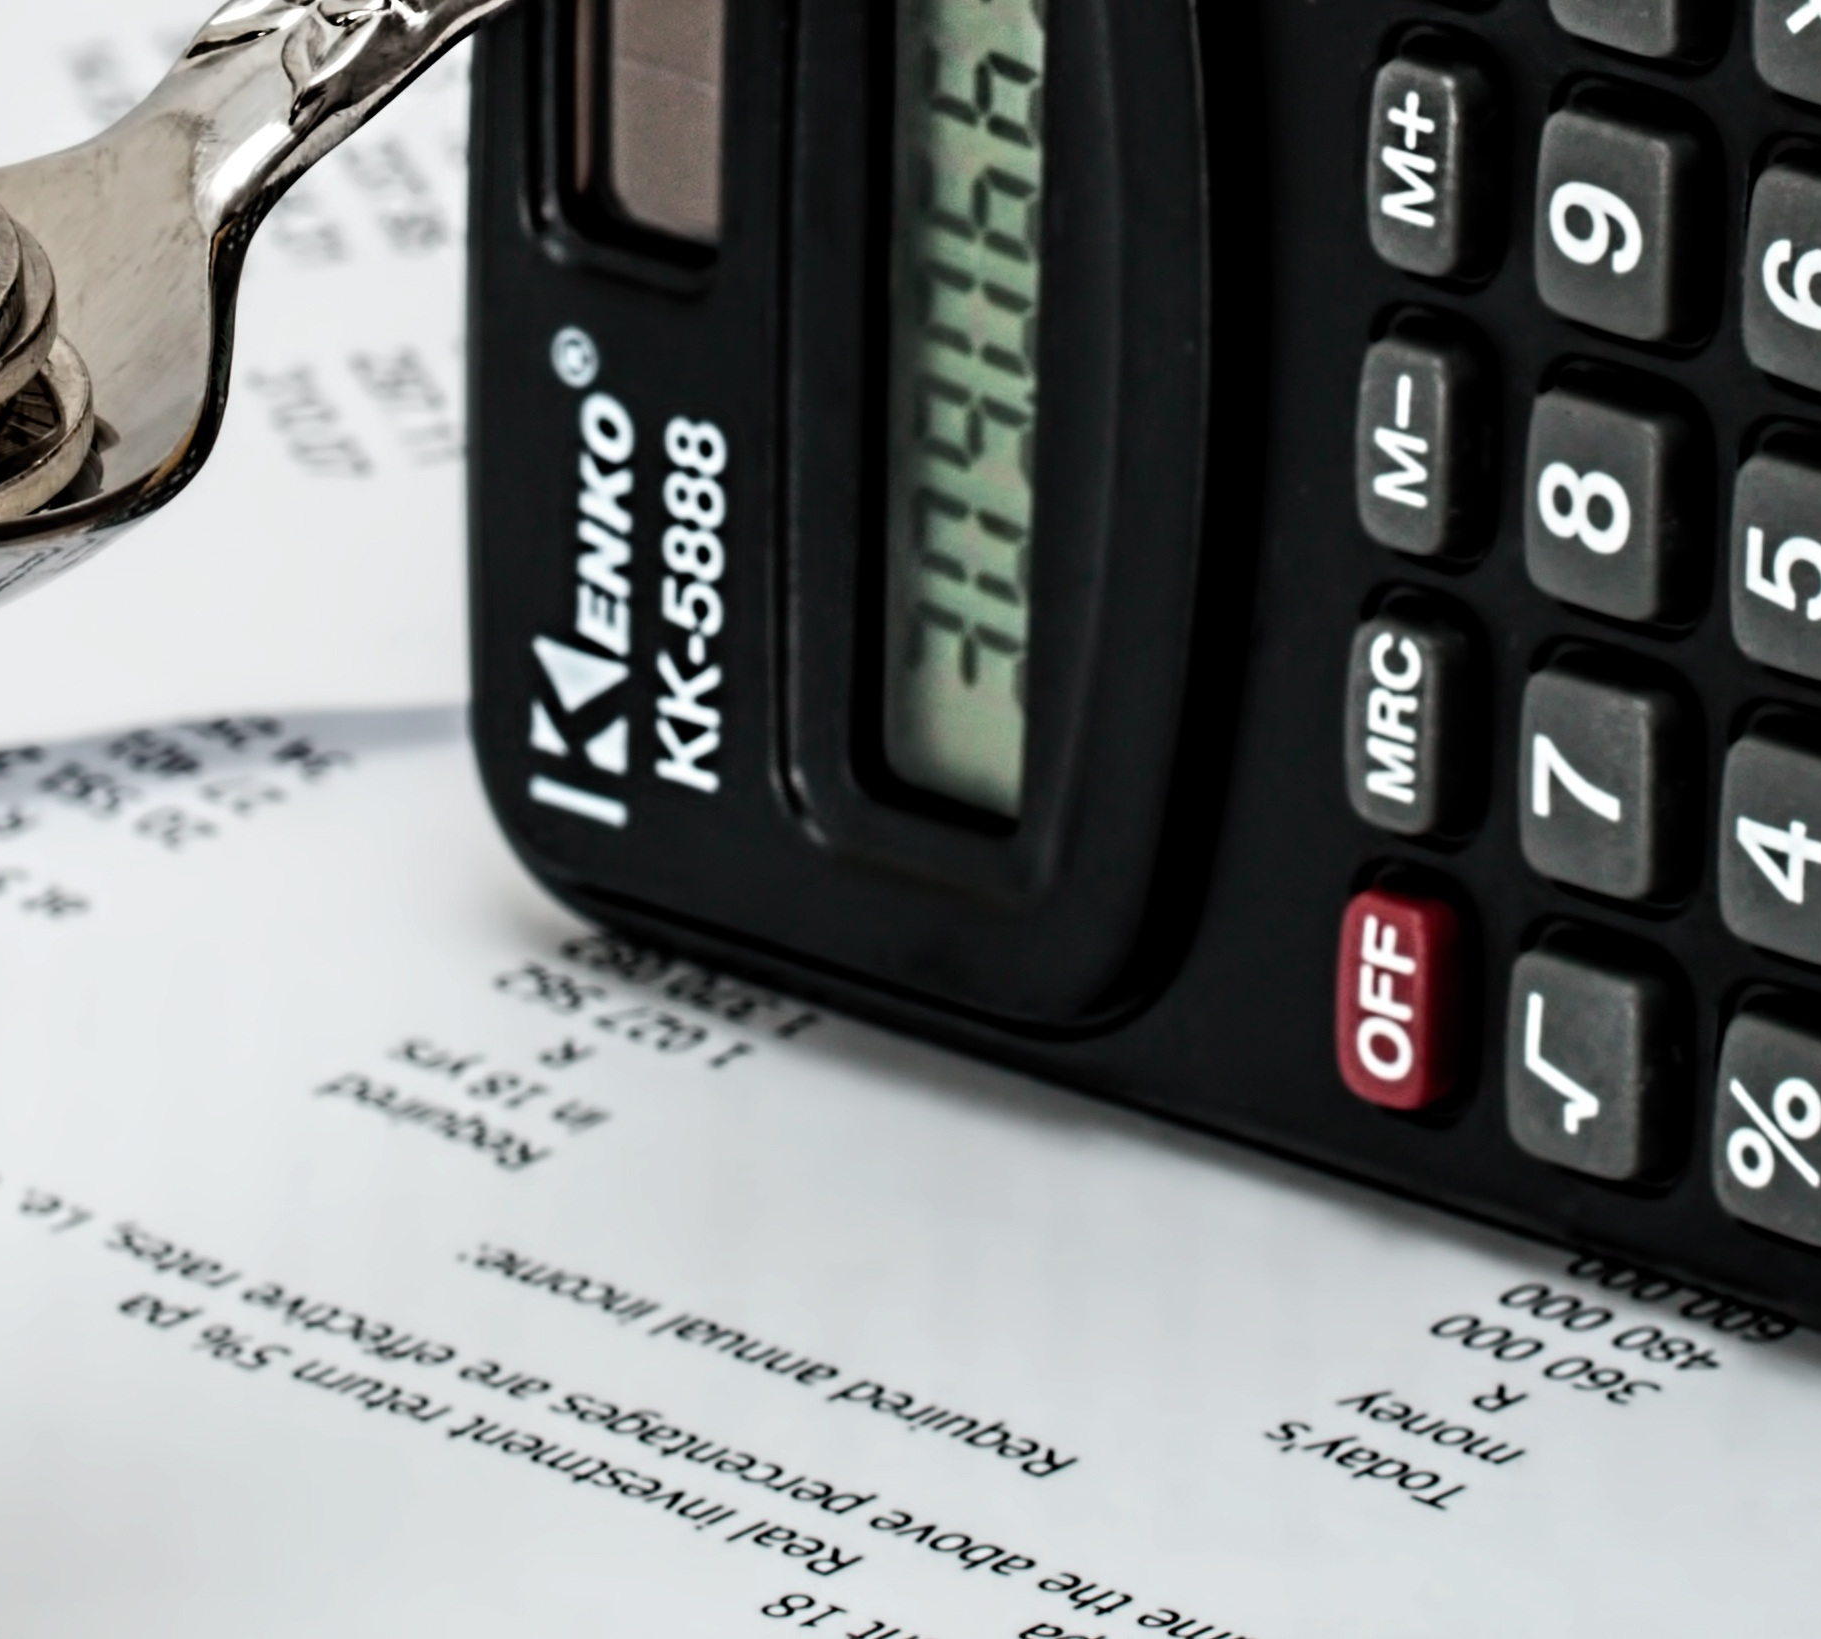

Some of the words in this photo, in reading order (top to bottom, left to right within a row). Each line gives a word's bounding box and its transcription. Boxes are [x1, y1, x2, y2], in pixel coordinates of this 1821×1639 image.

[1381, 91, 1436, 228] M+
[1549, 182, 1642, 273] 9
[1538, 463, 1630, 554] 8
[657, 419, 725, 791] KK-5888
[1366, 633, 1422, 803] MRC
[1533, 734, 1620, 821] 7
[1357, 915, 1416, 1080] OFF
[386, 1036, 484, 1080] yrs
[314, 1072, 552, 1173] Required
[104, 1220, 242, 1290] rates,
[455, 1241, 664, 1327] income:
[117, 1291, 204, 1332] pa
[241, 1281, 458, 1368] effective
[1429, 1313, 1546, 1363] 000
[1497, 1282, 1614, 1334] 000
[190, 1322, 292, 1373] 5%
[457, 1358, 552, 1401] are
[648, 1313, 840, 1388] annual
[1541, 1354, 1664, 1408] 360
[1610, 1325, 1722, 1373] 480
[290, 1358, 452, 1425] return
[827, 1378, 1080, 1478] Required
[1335, 1388, 1527, 1467] money
[1471, 1382, 1530, 1415] R
[446, 1412, 738, 1532] investment
[548, 1391, 878, 1517] percentages
[1264, 1418, 1467, 1512] Today's
[724, 1518, 865, 1579] Real
[869, 1508, 1037, 1578] above
[759, 1590, 850, 1631] 18
[1037, 1570, 1133, 1617] the
